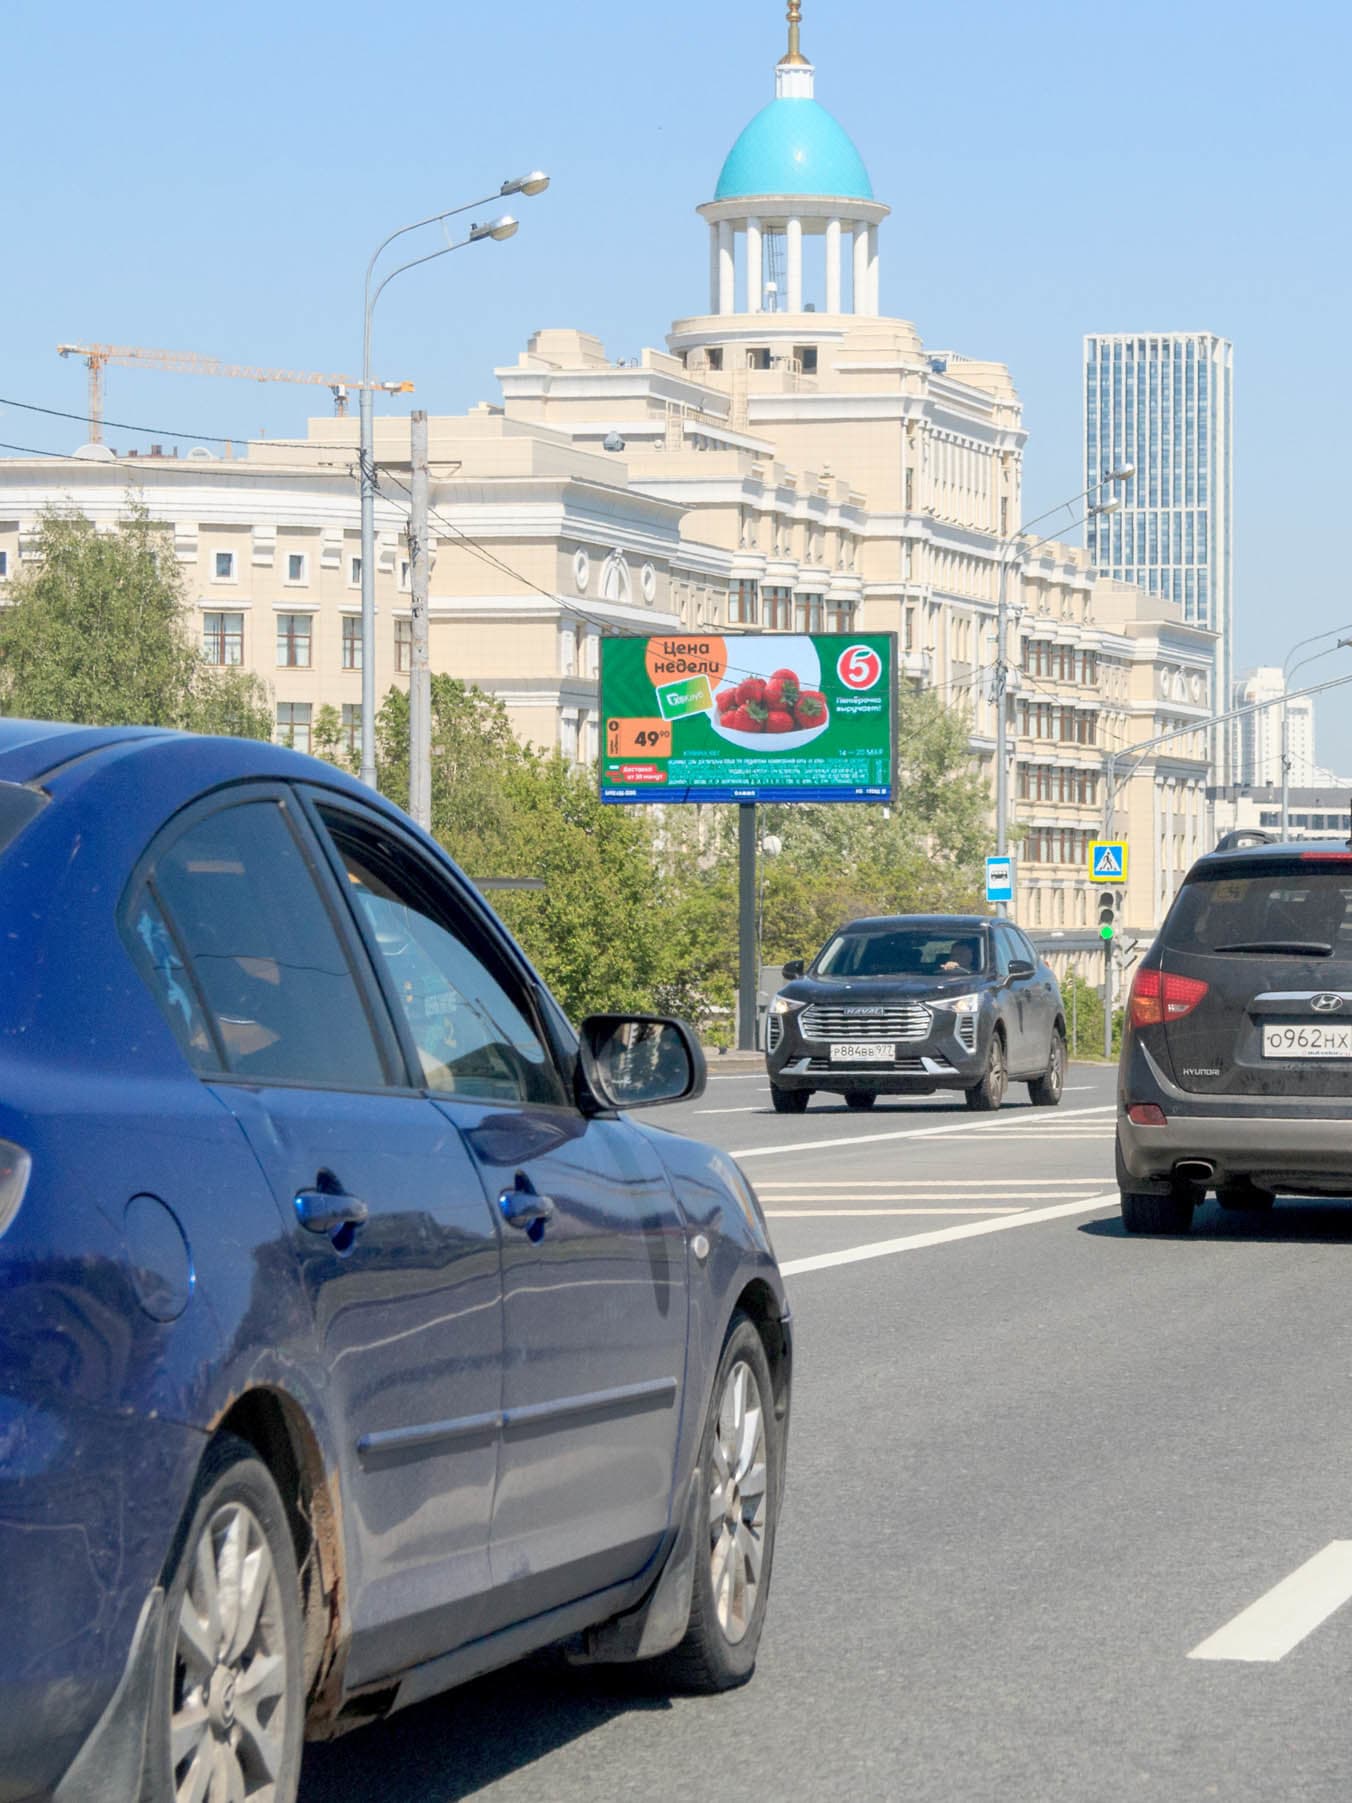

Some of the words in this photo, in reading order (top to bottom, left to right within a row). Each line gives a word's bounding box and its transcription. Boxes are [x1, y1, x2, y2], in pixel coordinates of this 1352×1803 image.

[663, 641, 710, 657] Цена
[654, 658, 719, 673] недели
[634, 731, 659, 747] 49
[1183, 1068, 1220, 1076] HYUNDAI
